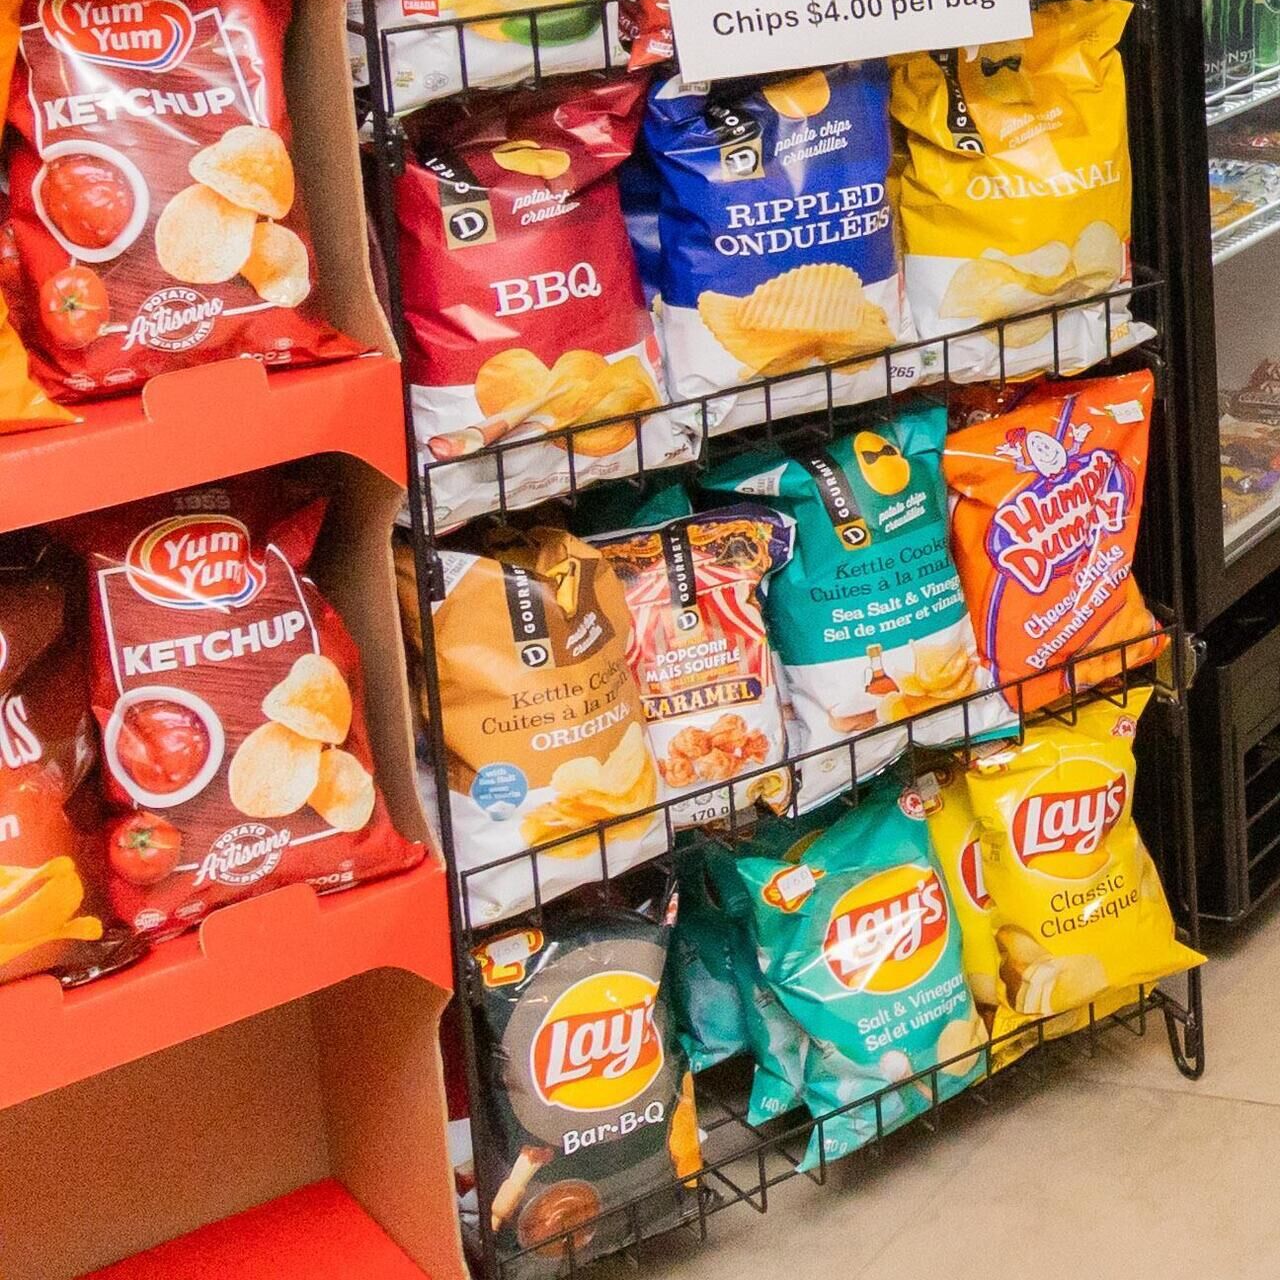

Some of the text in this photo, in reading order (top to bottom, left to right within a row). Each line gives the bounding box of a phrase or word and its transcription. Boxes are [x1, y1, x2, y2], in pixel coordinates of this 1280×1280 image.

[72, 1, 144, 28] Yum
[712, 4, 800, 36] Chips
[90, 26, 163, 53] Yum
[44, 86, 236, 130] KETCHUP
[774, 119, 852, 155] potato chips
[783, 135, 848, 165] croustilles
[731, 149, 757, 173] D
[725, 182, 885, 230] RIPPLED
[458, 211, 484, 240] D
[714, 204, 890, 256] ONDULÉES
[144, 290, 197, 312] POTATO
[490, 262, 602, 317] BBQ
[122, 297, 223, 351] Artisans
[889, 363, 915, 379] 265
[164, 529, 240, 568] Yum
[844, 527, 865, 544] D
[180, 561, 246, 593] Yum
[673, 535, 690, 601] GOURMET
[835, 556, 896, 580] Kettle
[810, 570, 913, 603] Cuites à la
[1091, 585, 1111, 608] au
[680, 613, 698, 629] D
[831, 591, 919, 623] Sea Salt &
[1023, 590, 1079, 639] Cheese
[823, 605, 930, 643] Sel de mer et
[123, 610, 305, 677] KETCHUP
[522, 646, 548, 666] D
[656, 638, 727, 666] POPCORN
[646, 665, 682, 683] MAÏS
[511, 683, 583, 711] Kettle
[642, 681, 754, 718] CARAMEL
[482, 698, 600, 736] Cuites à la
[1022, 780, 1125, 858] Lay's
[216, 825, 266, 849] POTATO
[192, 827, 291, 887] Artisans
[1050, 872, 1126, 913] Classic
[834, 879, 947, 977] Lay's
[1041, 889, 1139, 939] Classique
[857, 973, 968, 1035] Salt & Vinegar
[865, 989, 972, 1053] Sel et vinaigre
[760, 1097, 779, 1112] 140
